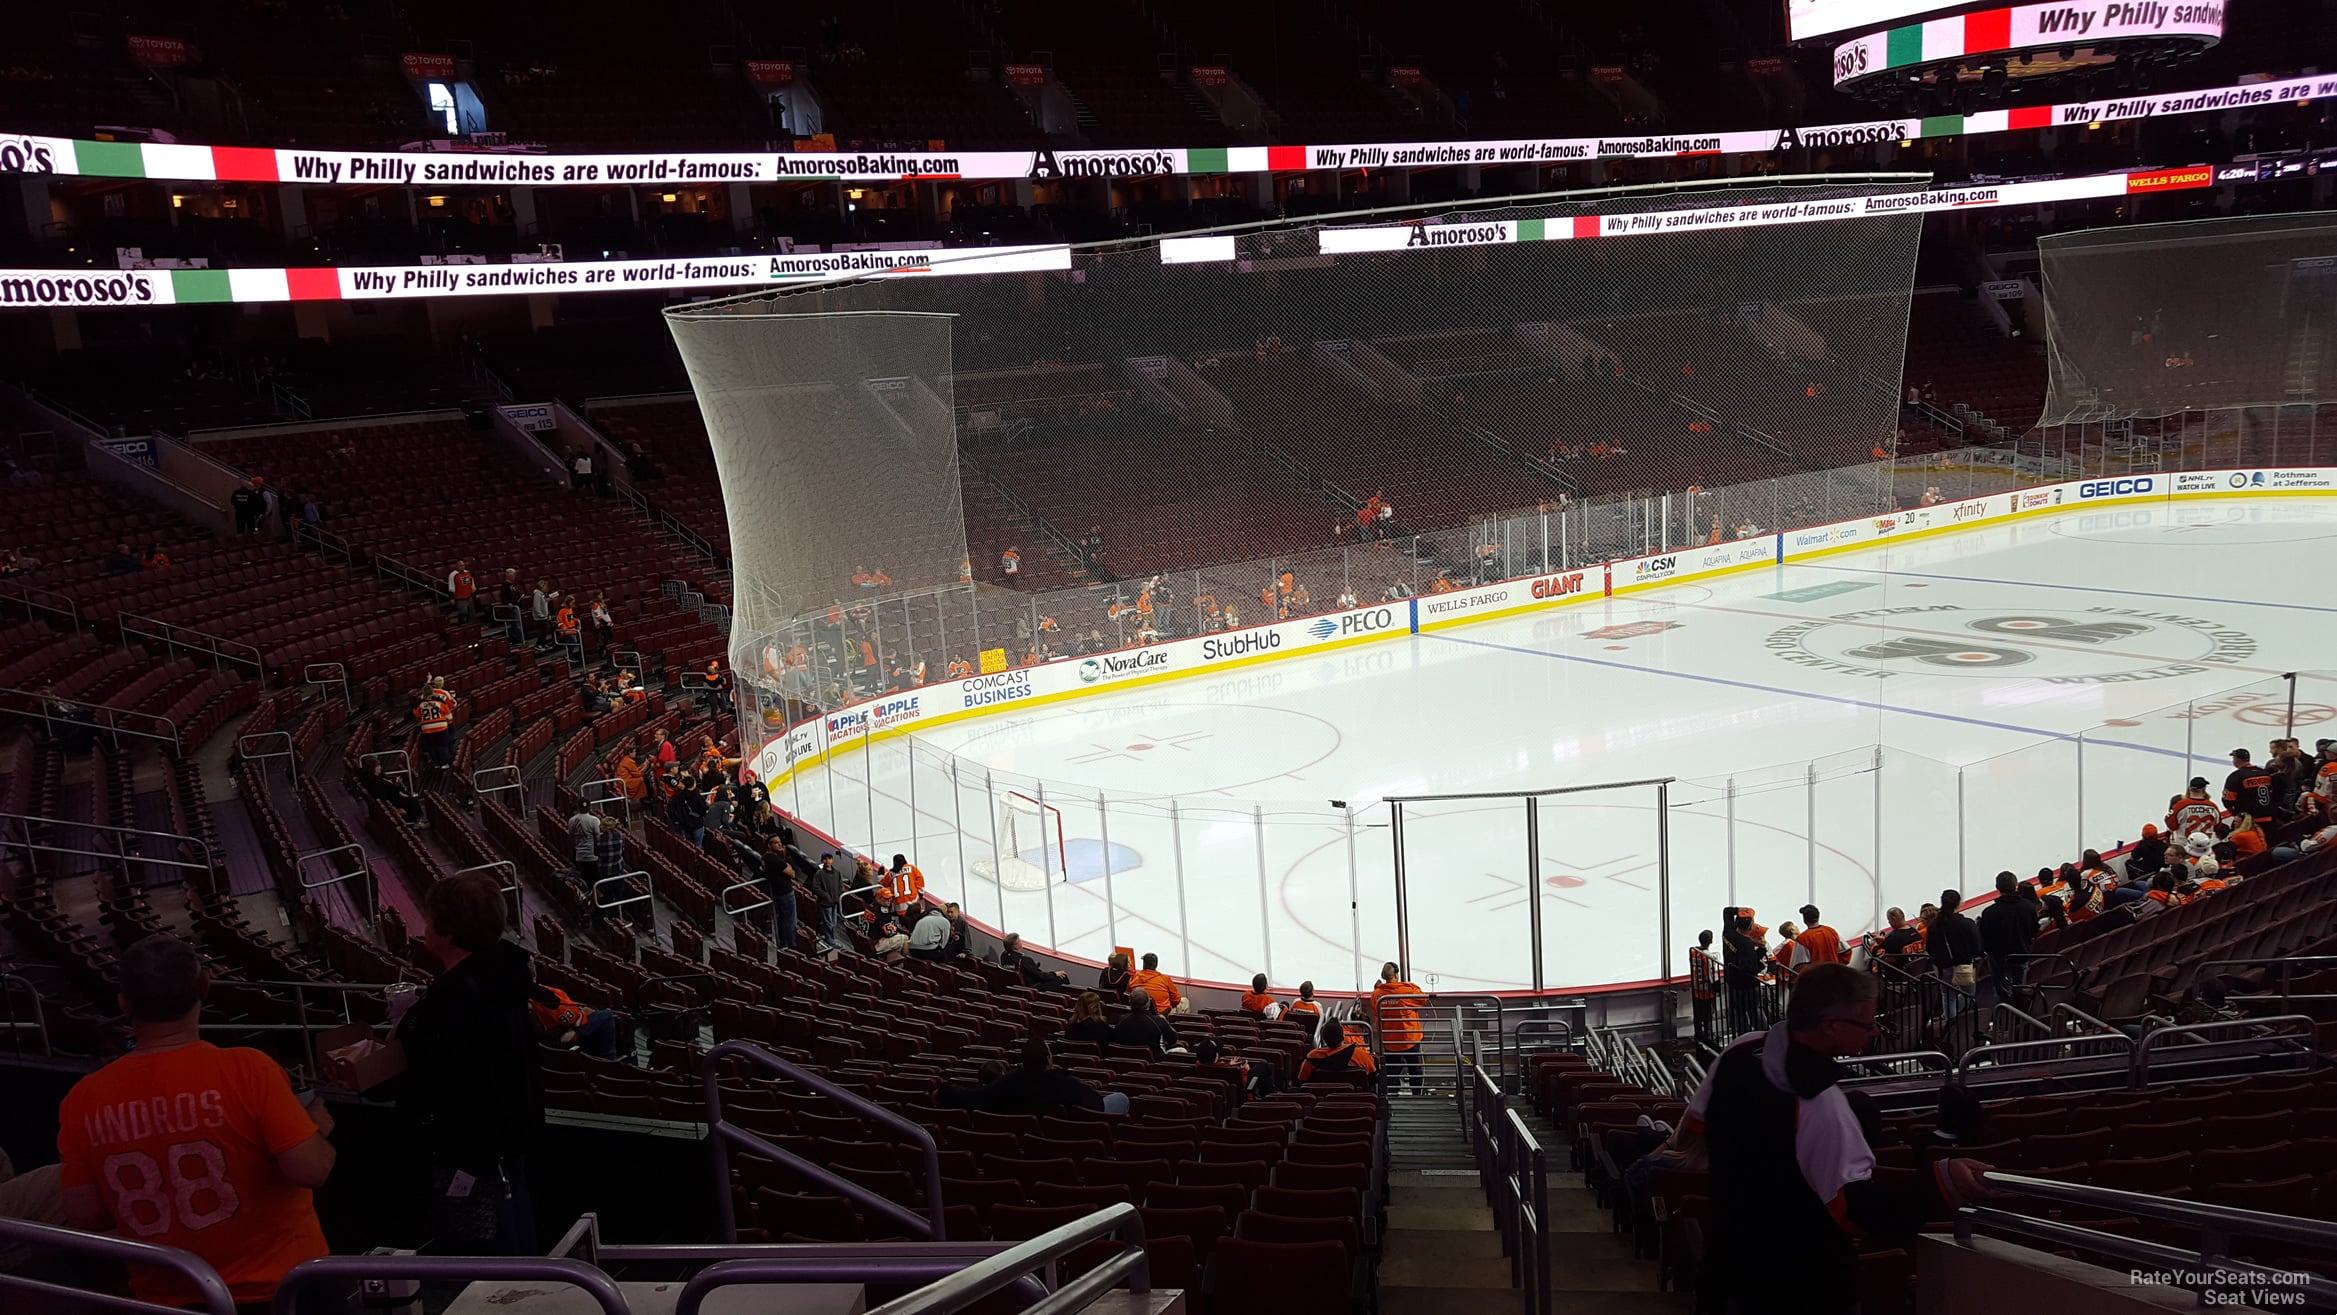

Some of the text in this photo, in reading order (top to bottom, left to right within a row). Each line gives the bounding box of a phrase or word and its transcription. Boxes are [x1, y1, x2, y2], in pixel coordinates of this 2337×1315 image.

[2039, 10, 2096, 34] Why
[2103, 2, 2168, 30] Philly
[417, 56, 453, 65] TOYOTA
[760, 63, 791, 71] TOYOTA
[2064, 106, 2100, 122] Why
[2105, 99, 2156, 117] Philly
[2161, 86, 2272, 113] sandwiches
[2279, 83, 2310, 100] are
[1597, 137, 1721, 155] AmorosoBaking.com
[1773, 122, 1906, 151] Amoroso's
[777, 155, 959, 176] AmorosoBaking.com
[1028, 150, 1175, 177] Amoroso's
[1316, 149, 1346, 168] Why
[1350, 147, 1389, 167] Philly
[1392, 146, 1472, 163] sandwiches
[1474, 148, 1496, 161] are
[294, 156, 342, 183] Why
[350, 158, 416, 184] Philly
[424, 160, 555, 181] sandwiches
[563, 164, 599, 180] are
[2128, 172, 2209, 188] WELLS FARGO
[1865, 188, 1998, 210] AmorosoBaking.com
[1607, 217, 1629, 232] Why
[1631, 214, 1663, 230] Philly
[1666, 209, 1735, 227] sandwiches
[1739, 210, 1758, 221] are
[1407, 224, 1507, 247] Amoroso's
[770, 254, 930, 274] AmorosoBaking.com
[0, 273, 152, 303] moroso's
[354, 271, 397, 293] Why
[404, 269, 460, 291] Philly
[466, 267, 578, 287] sandwiches
[585, 268, 615, 283] are
[1988, 282, 2020, 291] GEICO
[871, 381, 906, 391] GEICO
[507, 407, 548, 419] GEICO
[538, 419, 553, 429] 115
[2273, 471, 2317, 479] Rothman
[2285, 478, 2330, 487] Jefferson
[2079, 478, 2153, 499] GEICO
[1904, 512, 1916, 525] 20
[1953, 502, 1988, 521] xfinity
[1796, 532, 1829, 547] Walmart
[1651, 556, 1677, 572] CSN
[1739, 546, 1769, 561] AQUAFINA
[1531, 573, 1584, 599] GIANT
[1427, 591, 1508, 615] WELLS FARGO
[1342, 608, 1392, 635] PECO
[1203, 629, 1281, 660] StubHub
[1102, 651, 1168, 674] NovaCare
[1775, 650, 1898, 679] CENTER
[963, 670, 1030, 693] COMCAST
[964, 684, 1032, 708] BUSINESS
[422, 706, 441, 720] 28
[879, 697, 919, 718] APPLE
[874, 709, 920, 729] VACATIONS
[798, 742, 812, 756] LIVE
[2257, 785, 2270, 806] 9
[2185, 814, 2215, 840] 22
[892, 873, 912, 898] 11
[103, 1140, 240, 1237] 88
